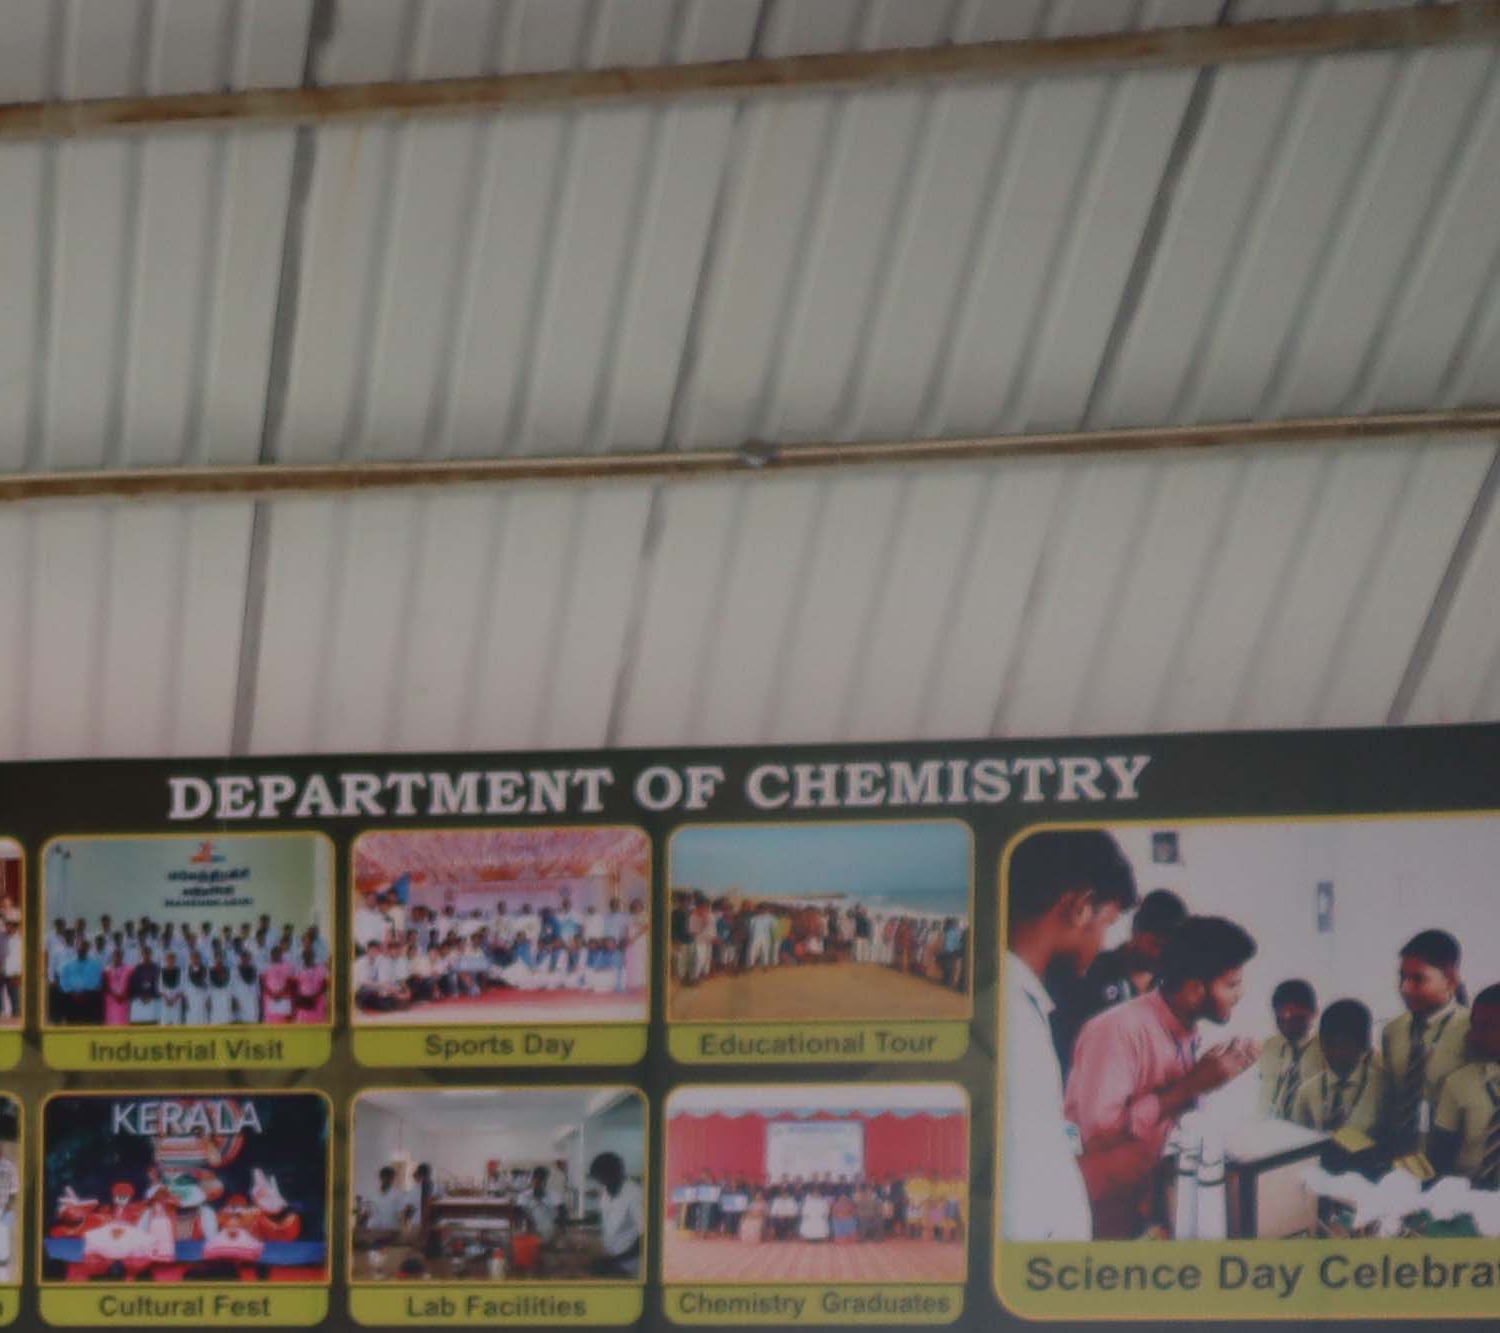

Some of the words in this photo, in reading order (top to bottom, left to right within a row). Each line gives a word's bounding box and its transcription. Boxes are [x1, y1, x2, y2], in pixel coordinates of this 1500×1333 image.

[169, 770, 613, 820] DEPARTMENT
[633, 764, 725, 810] OF
[744, 755, 1151, 809] CHEMISTRY
[90, 1040, 216, 1062] Industrial
[226, 1038, 284, 1061] Visit
[425, 1033, 514, 1059] Sports
[524, 1032, 574, 1059] Day
[701, 1032, 865, 1056] Educational
[875, 1031, 938, 1054] Tour
[112, 1100, 263, 1135] KERALA
[1025, 1256, 1200, 1292] Science
[1218, 1255, 1304, 1298] Day
[1318, 1253, 1500, 1290] Celebra
[99, 1294, 204, 1317] Cultural
[214, 1294, 271, 1317] Fest
[407, 1295, 456, 1317] Lab
[467, 1294, 587, 1317] Facilities
[679, 1291, 805, 1319] Chemistry
[821, 1290, 950, 1315] Graduates
